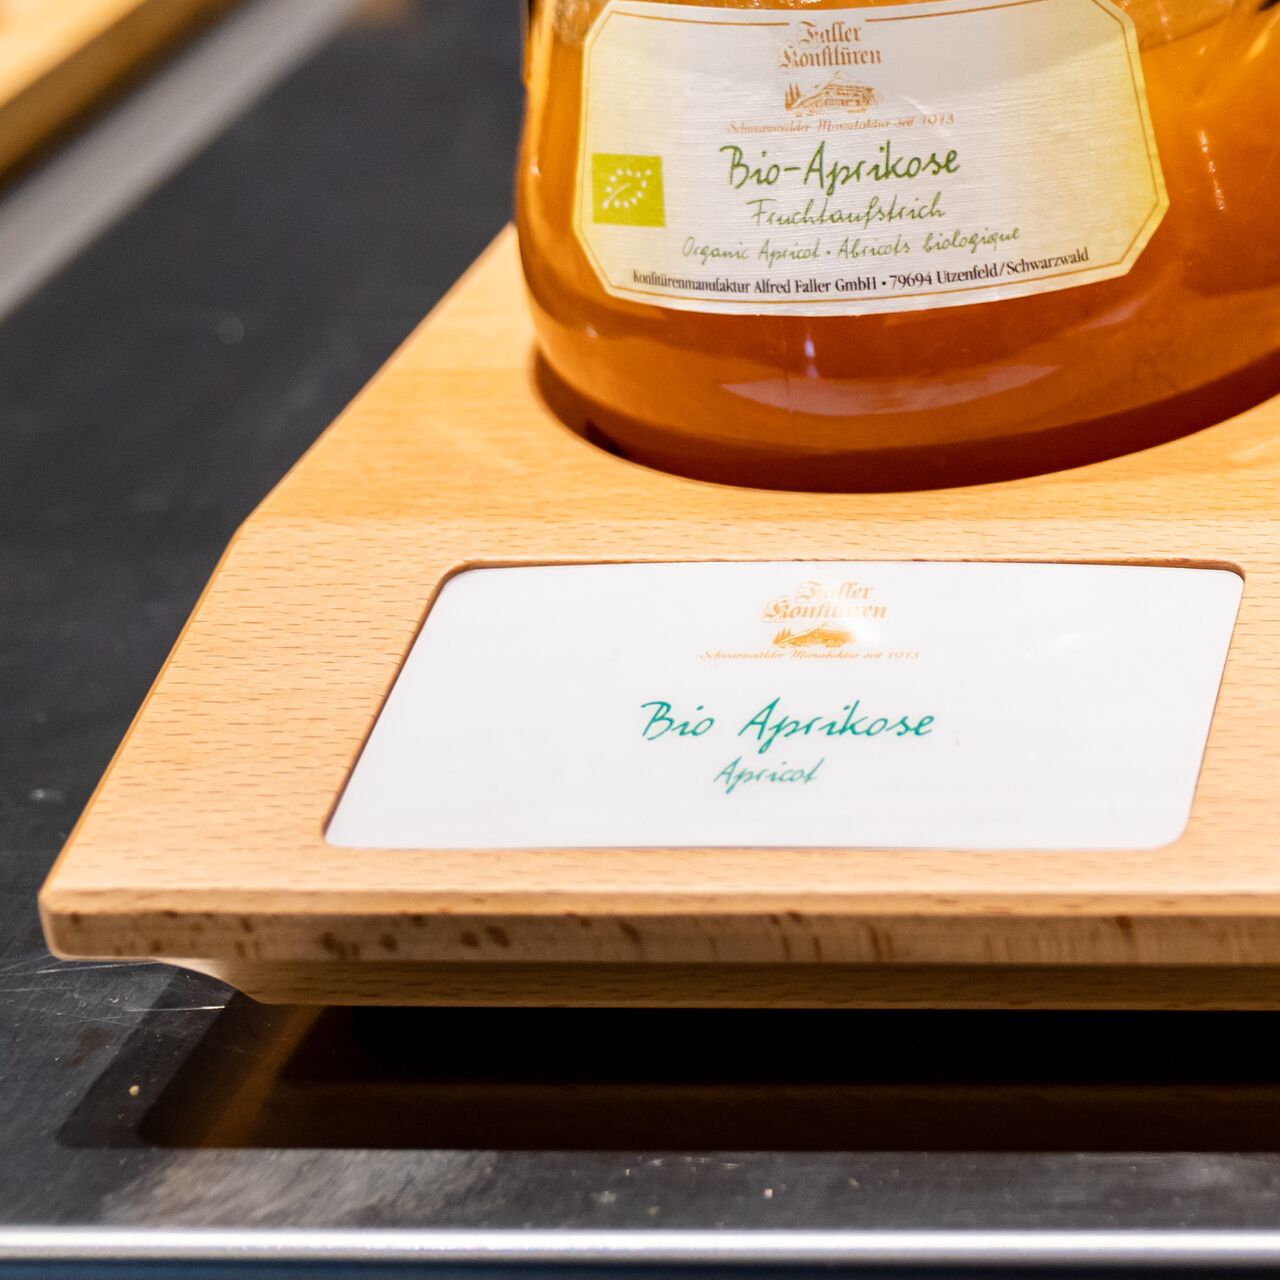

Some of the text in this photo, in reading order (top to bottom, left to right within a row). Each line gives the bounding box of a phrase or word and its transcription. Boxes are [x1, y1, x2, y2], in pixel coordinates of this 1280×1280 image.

[799, 21, 863, 46] Faller
[778, 45, 883, 70] Konfitüren
[720, 140, 960, 196] Bio-Aprikose
[746, 191, 946, 229] Fruchtaufstrich
[682, 226, 1020, 269] Organic Apricot Abricots biologique
[632, 247, 1090, 295] Konfitürenmanufaktur Alfred Faller GmbH 79694 Utzenfeld/Schwarzwald
[762, 596, 889, 622] Konfitren
[640, 696, 936, 754] Bio Aprikose
[713, 755, 826, 795] Apricot
